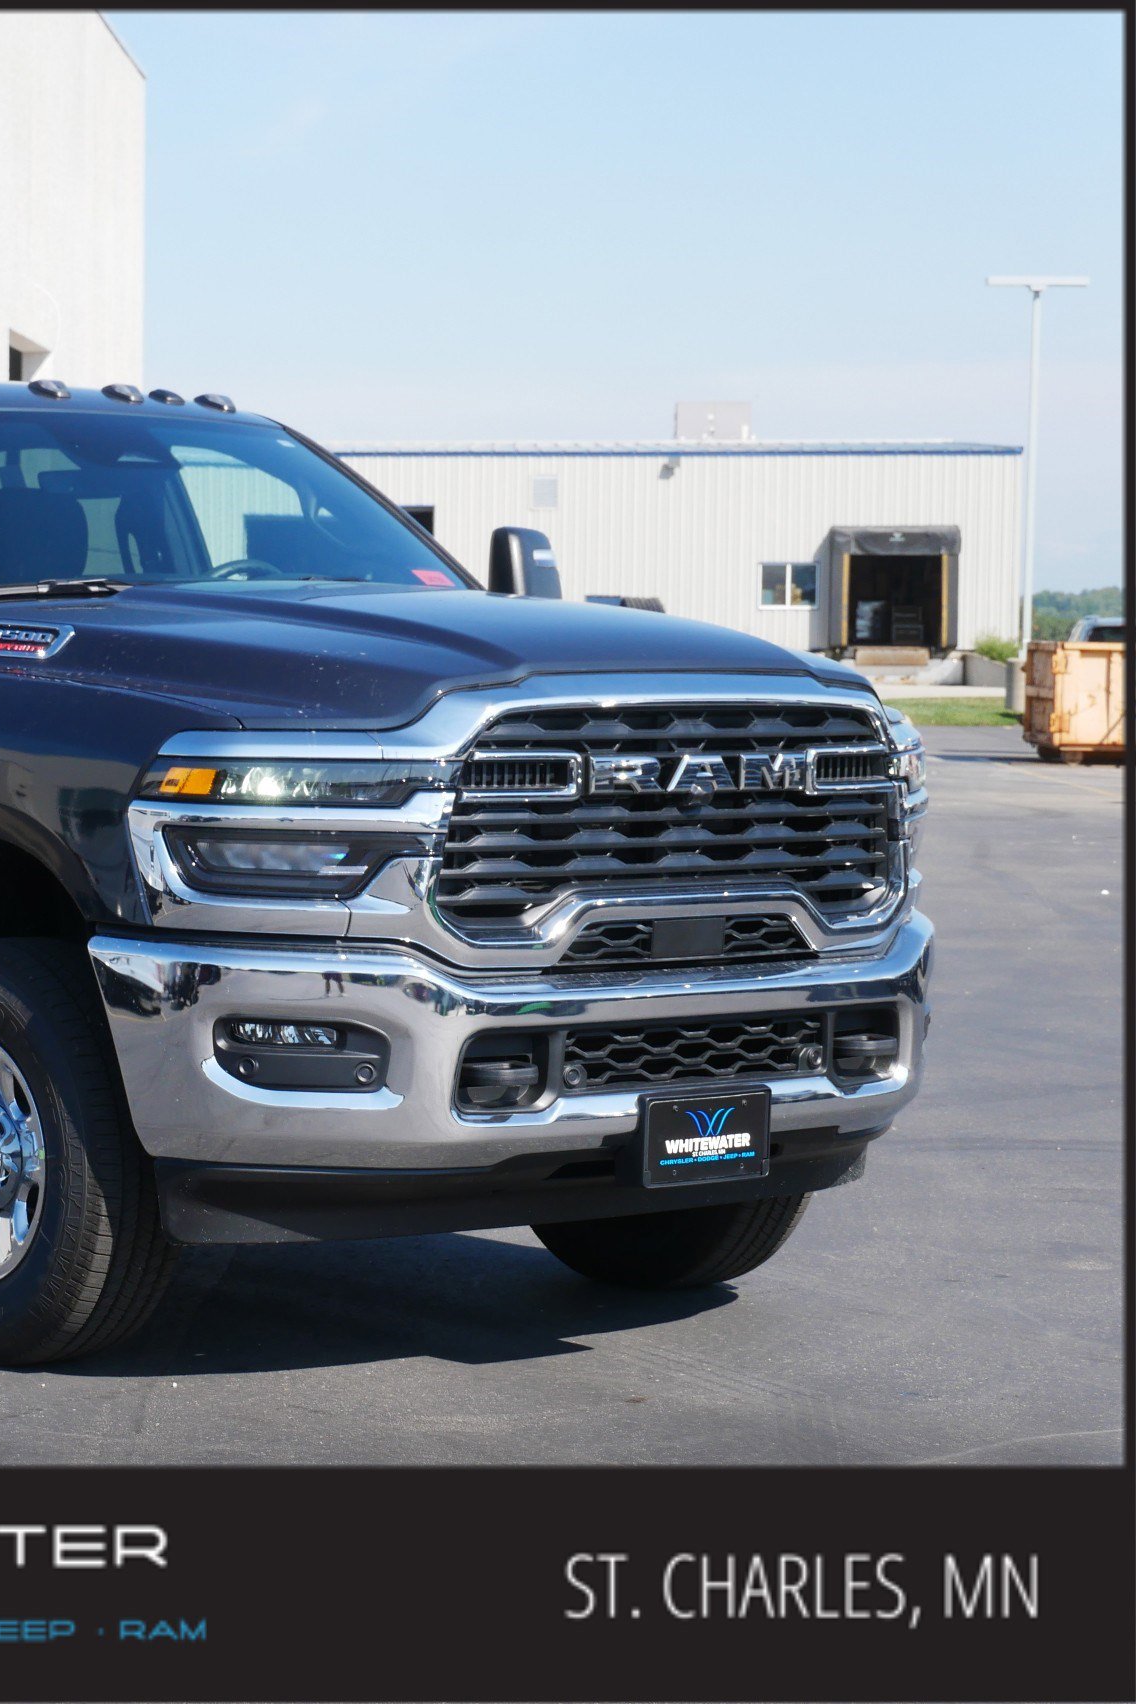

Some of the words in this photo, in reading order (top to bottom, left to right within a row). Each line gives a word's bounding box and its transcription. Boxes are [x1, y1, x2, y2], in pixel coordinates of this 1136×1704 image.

[589, 753, 806, 795] RAM
[665, 1132, 751, 1154] WHITEWATER
[722, 1152, 738, 1160] JEEP
